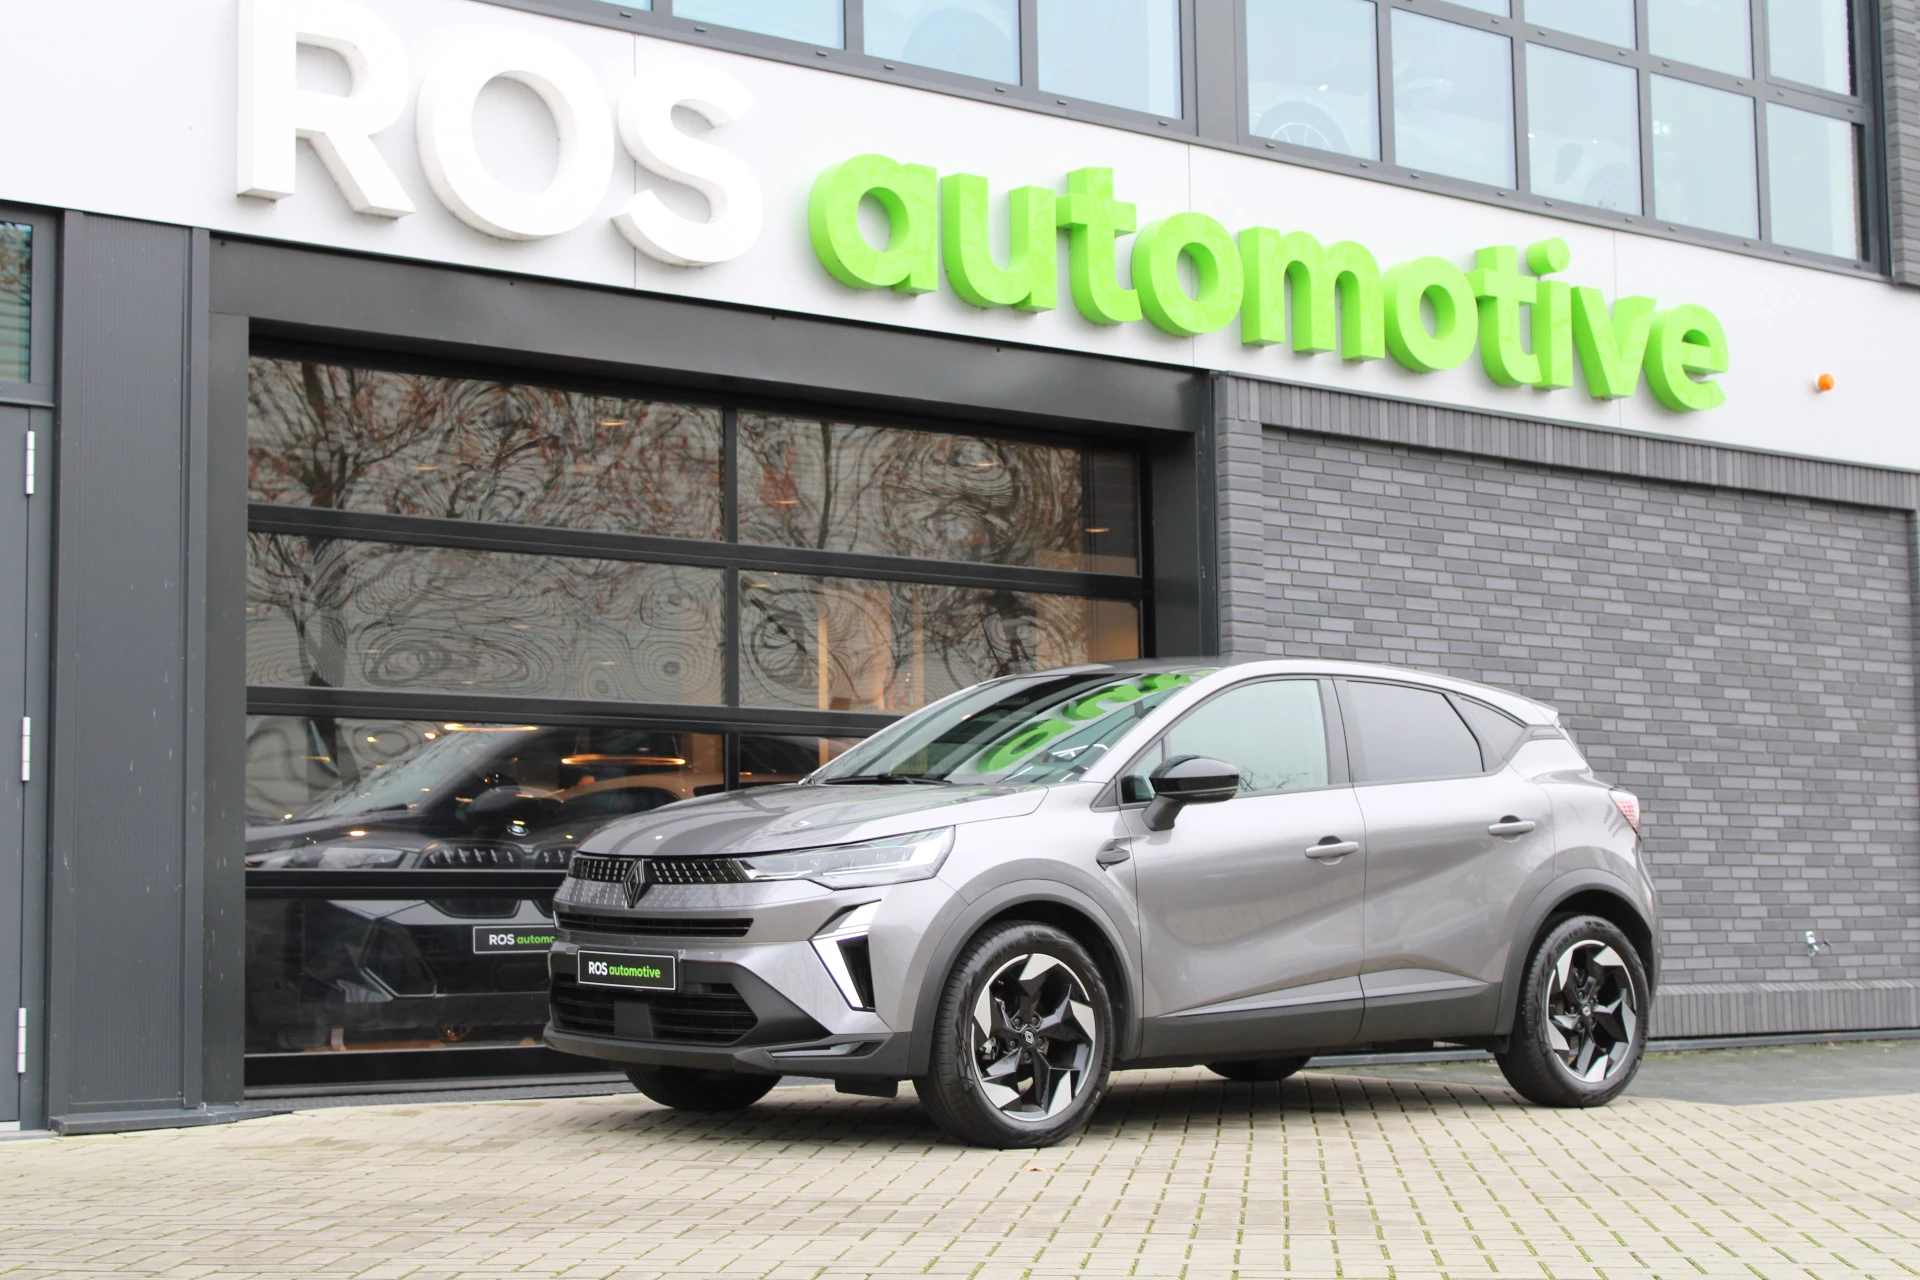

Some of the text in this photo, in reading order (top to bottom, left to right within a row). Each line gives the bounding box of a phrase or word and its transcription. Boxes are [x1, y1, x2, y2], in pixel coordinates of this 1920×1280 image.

[236, 0, 1728, 412] ROS automotive
[488, 934, 556, 946] ROS automo
[588, 961, 662, 979] ROS automotive
